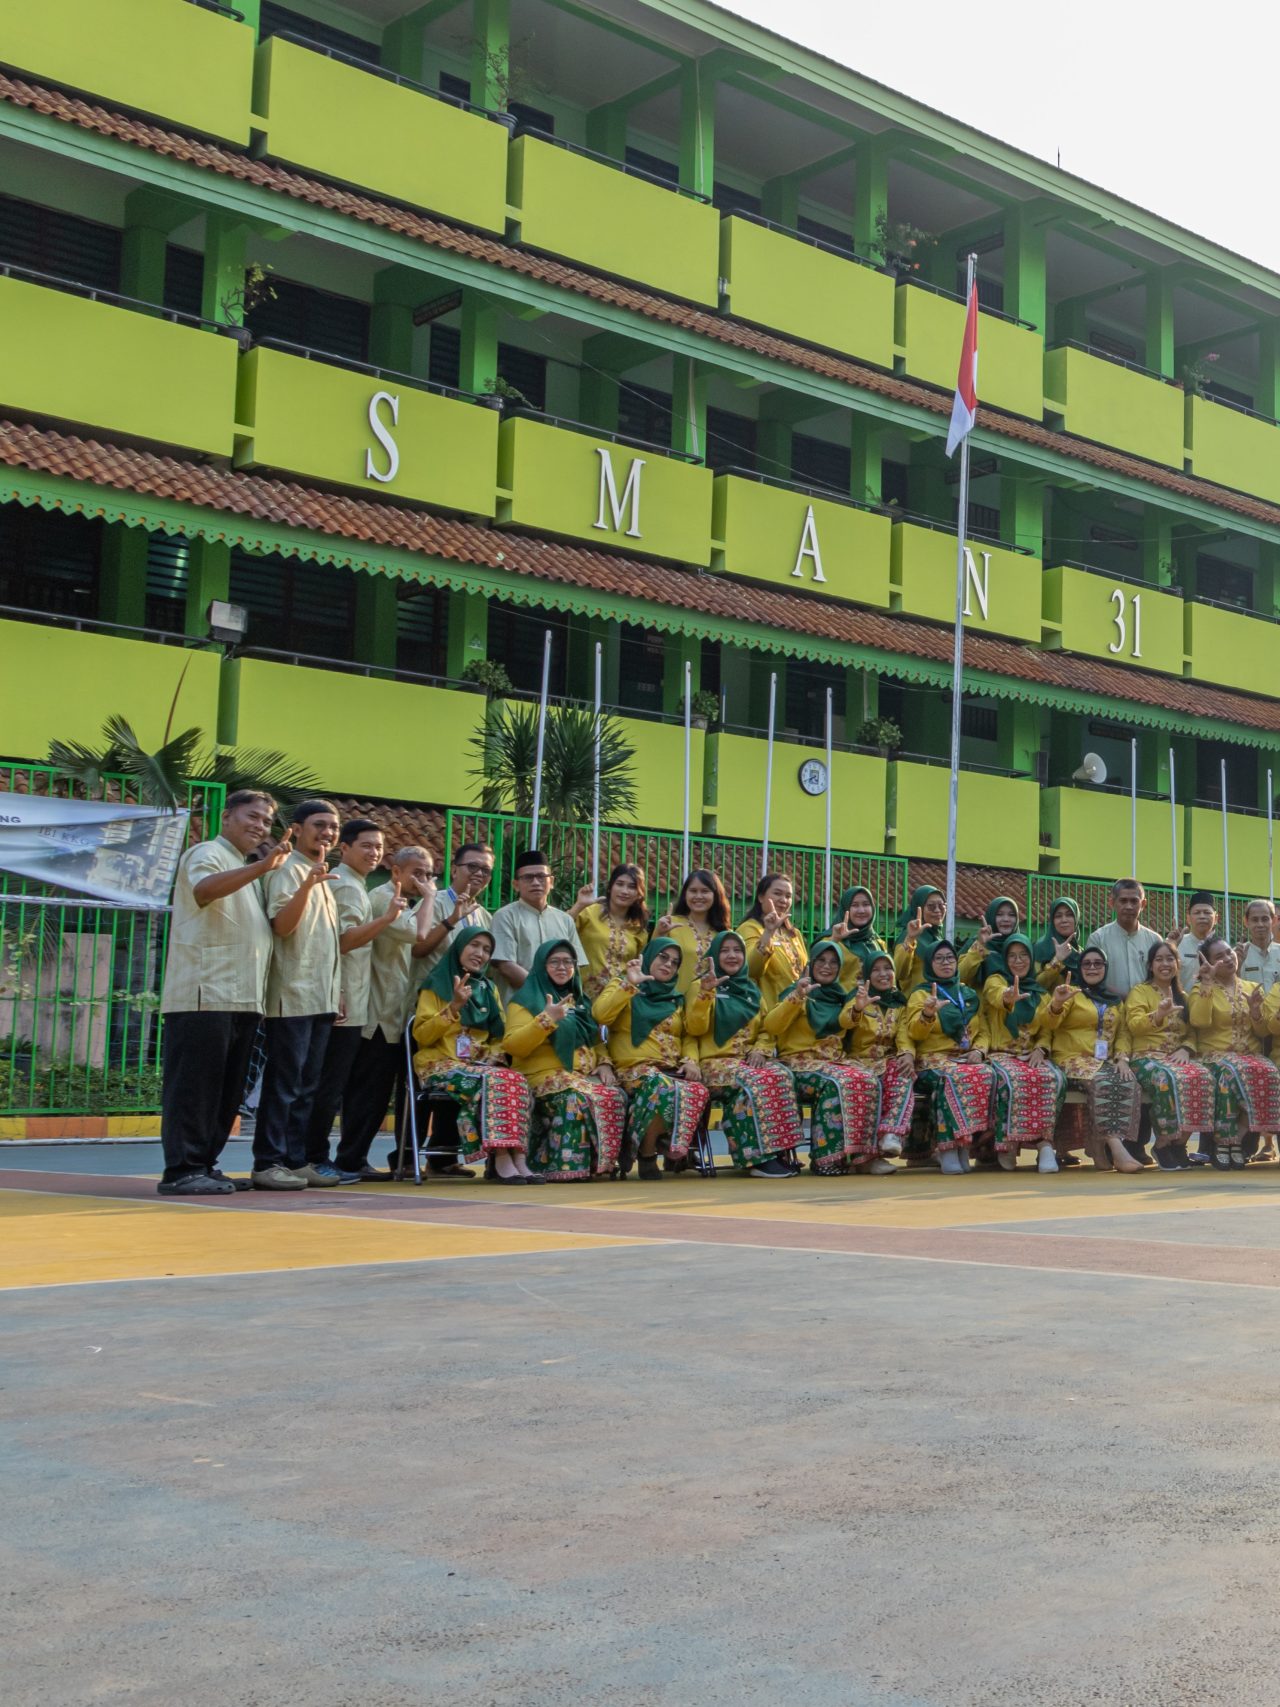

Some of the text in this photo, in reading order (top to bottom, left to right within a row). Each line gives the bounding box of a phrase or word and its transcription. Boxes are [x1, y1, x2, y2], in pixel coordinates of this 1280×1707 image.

[366, 391, 1142, 658] S M A N 31
